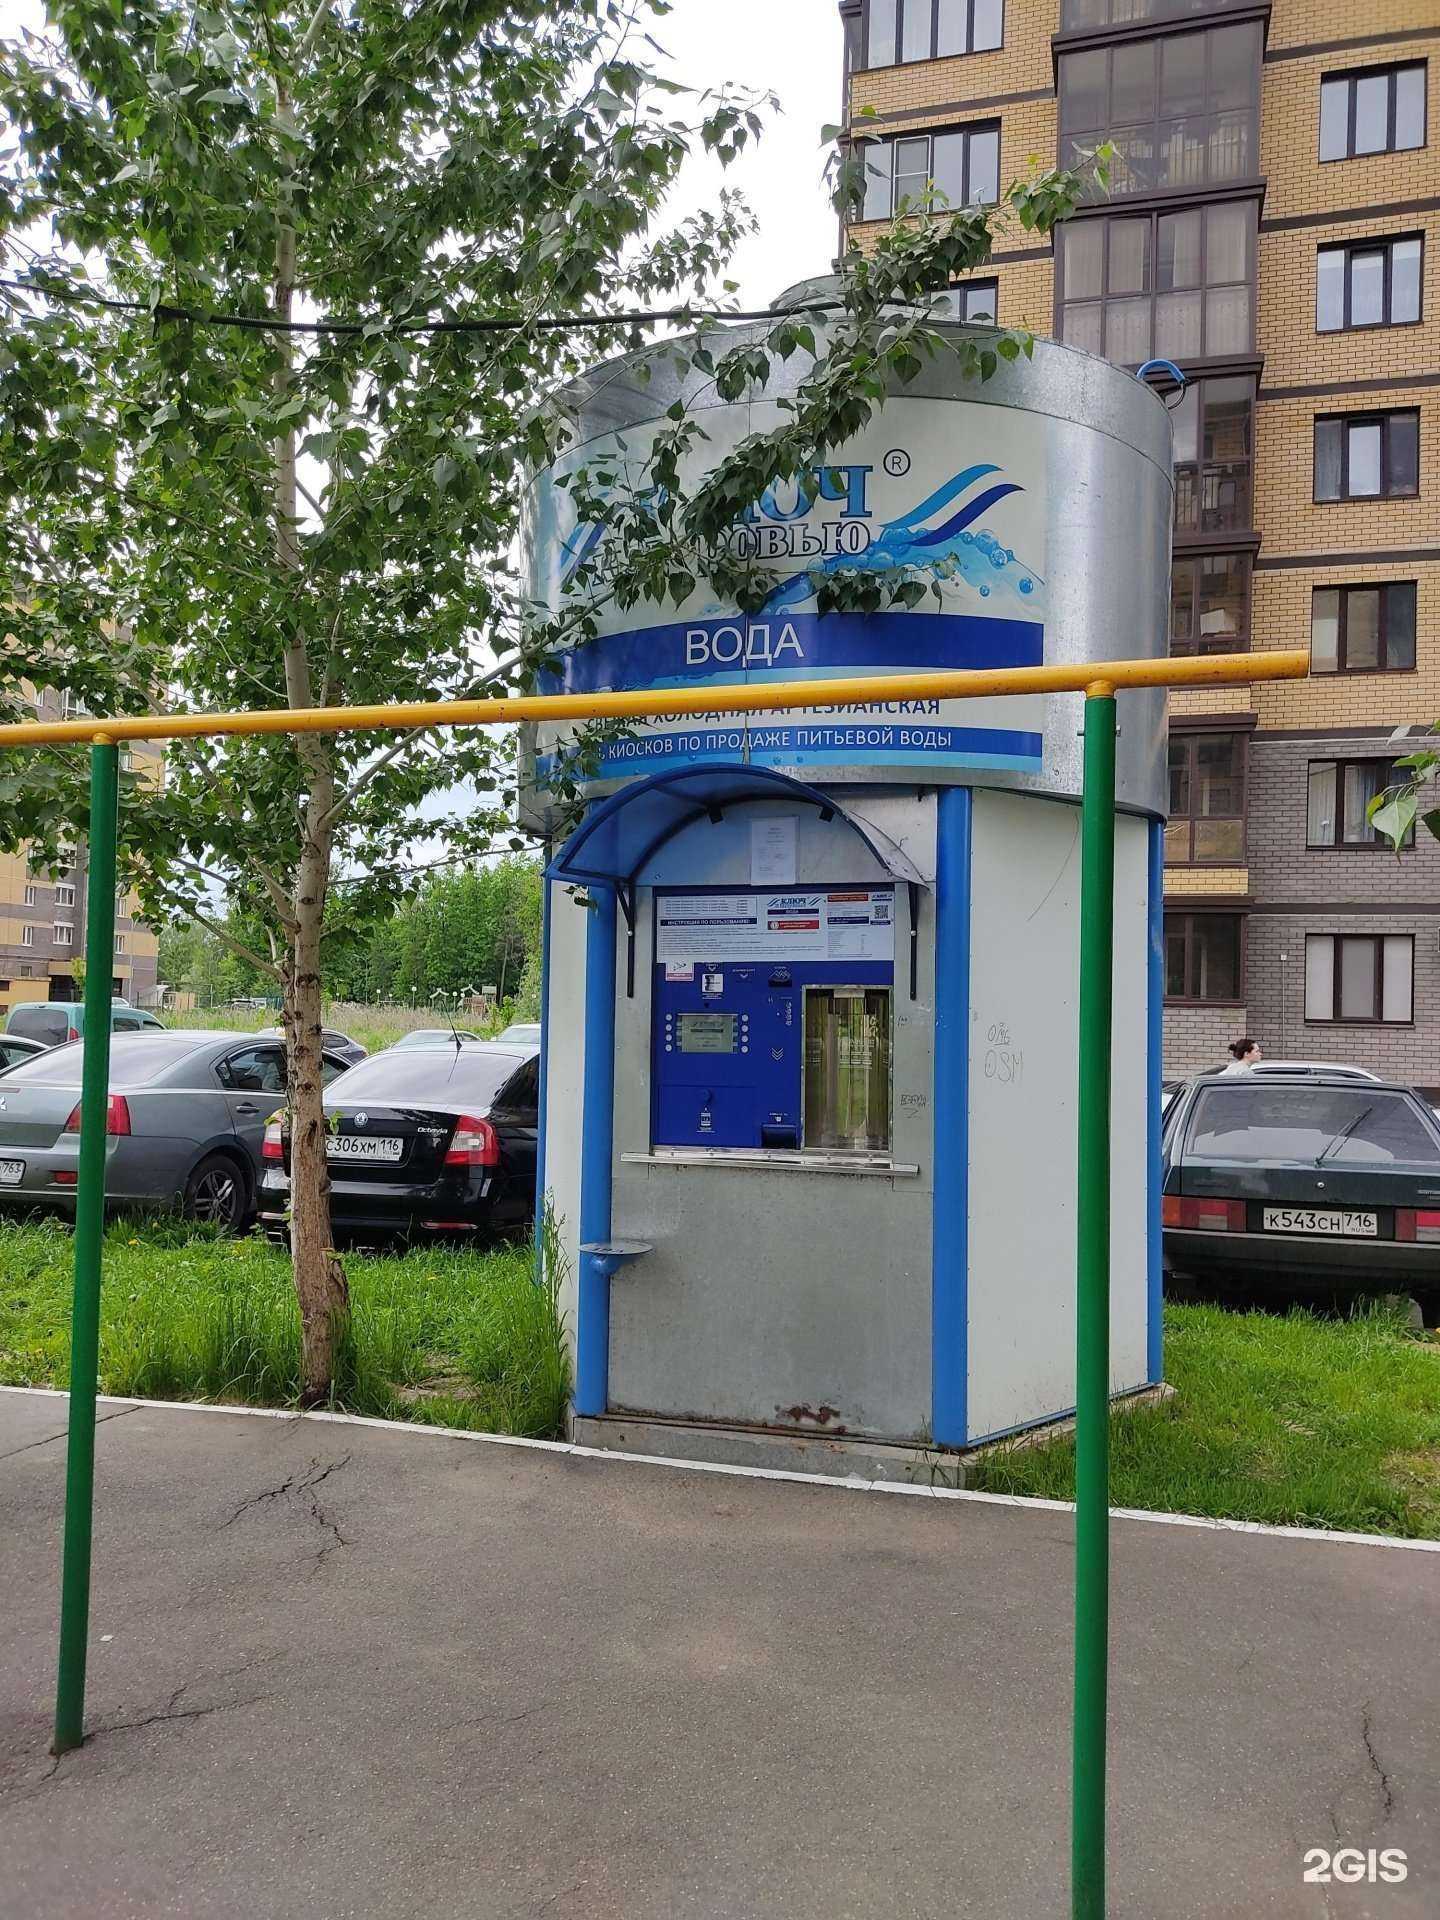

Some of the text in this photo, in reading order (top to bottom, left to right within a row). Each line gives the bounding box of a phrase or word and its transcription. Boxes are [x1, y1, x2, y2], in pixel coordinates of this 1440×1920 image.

[685, 623, 804, 668] ВОДА
[608, 738, 673, 760] КИОСКОВ
[678, 736, 701, 752] ПО
[706, 731, 791, 751] ПРОДАЖЕ
[796, 726, 893, 746] ПИТЬЕВОЙ
[900, 731, 952, 749] ВОДЫ
[380, 1138, 399, 1151] 116
[1269, 1211, 1372, 1231] К543СН 716
